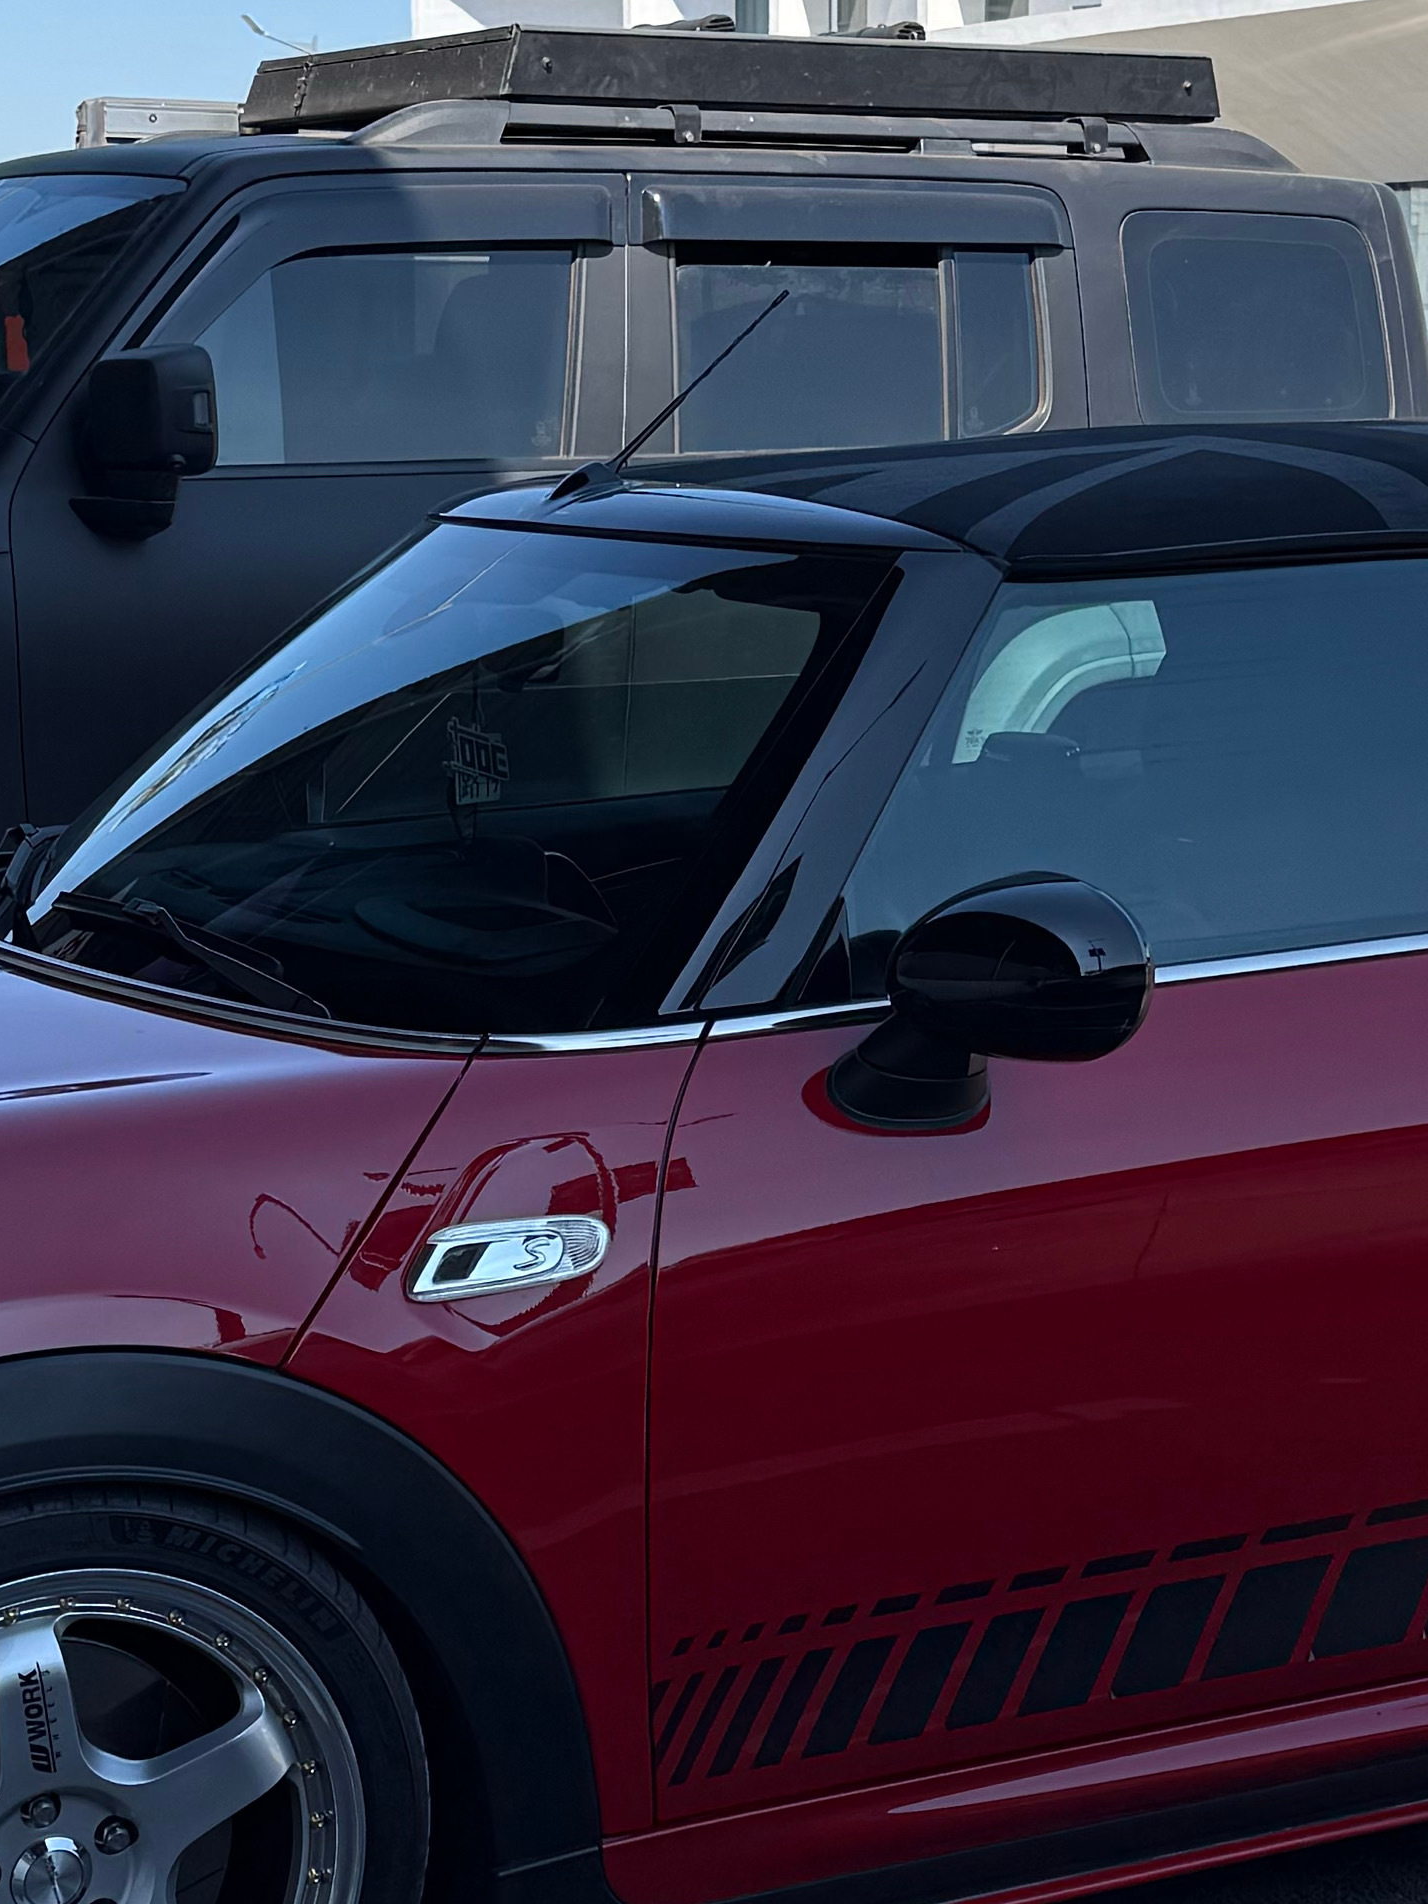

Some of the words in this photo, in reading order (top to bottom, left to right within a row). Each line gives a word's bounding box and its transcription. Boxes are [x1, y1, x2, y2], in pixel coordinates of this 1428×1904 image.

[513, 1236, 552, 1271] S
[163, 1524, 341, 1634] MICHELIN
[18, 1669, 47, 1743] WORK
